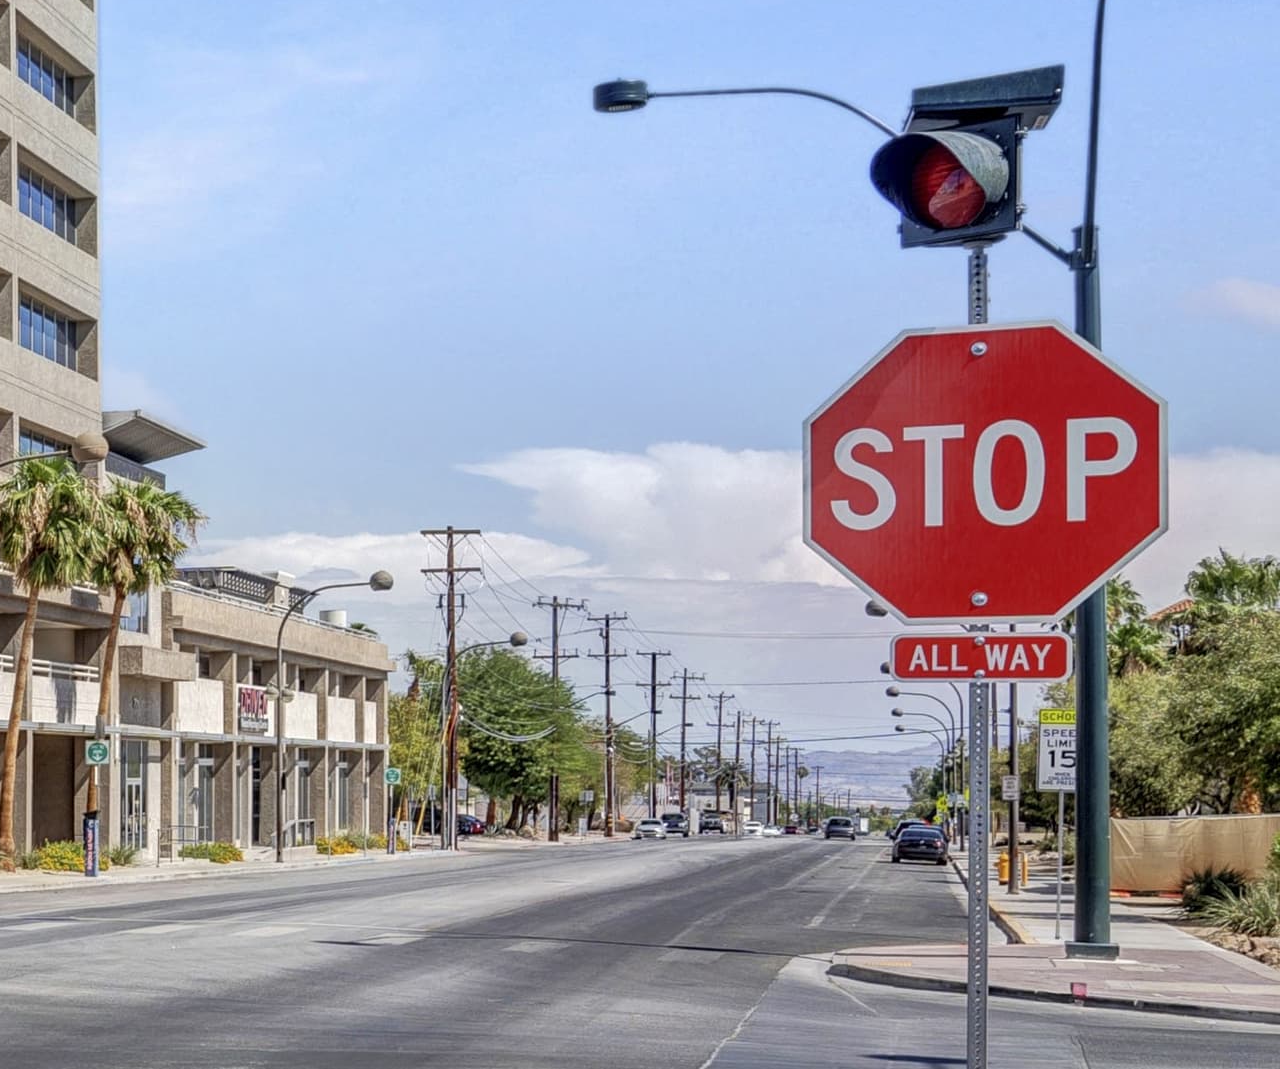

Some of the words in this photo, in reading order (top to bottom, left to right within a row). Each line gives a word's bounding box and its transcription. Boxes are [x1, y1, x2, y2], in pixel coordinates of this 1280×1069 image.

[830, 416, 1138, 530] STOP
[909, 644, 968, 672] ALL
[984, 643, 1052, 672] WAY
[1042, 712, 1075, 721] SCHO
[1043, 729, 1076, 737] SPEE
[1048, 750, 1076, 768] 15
